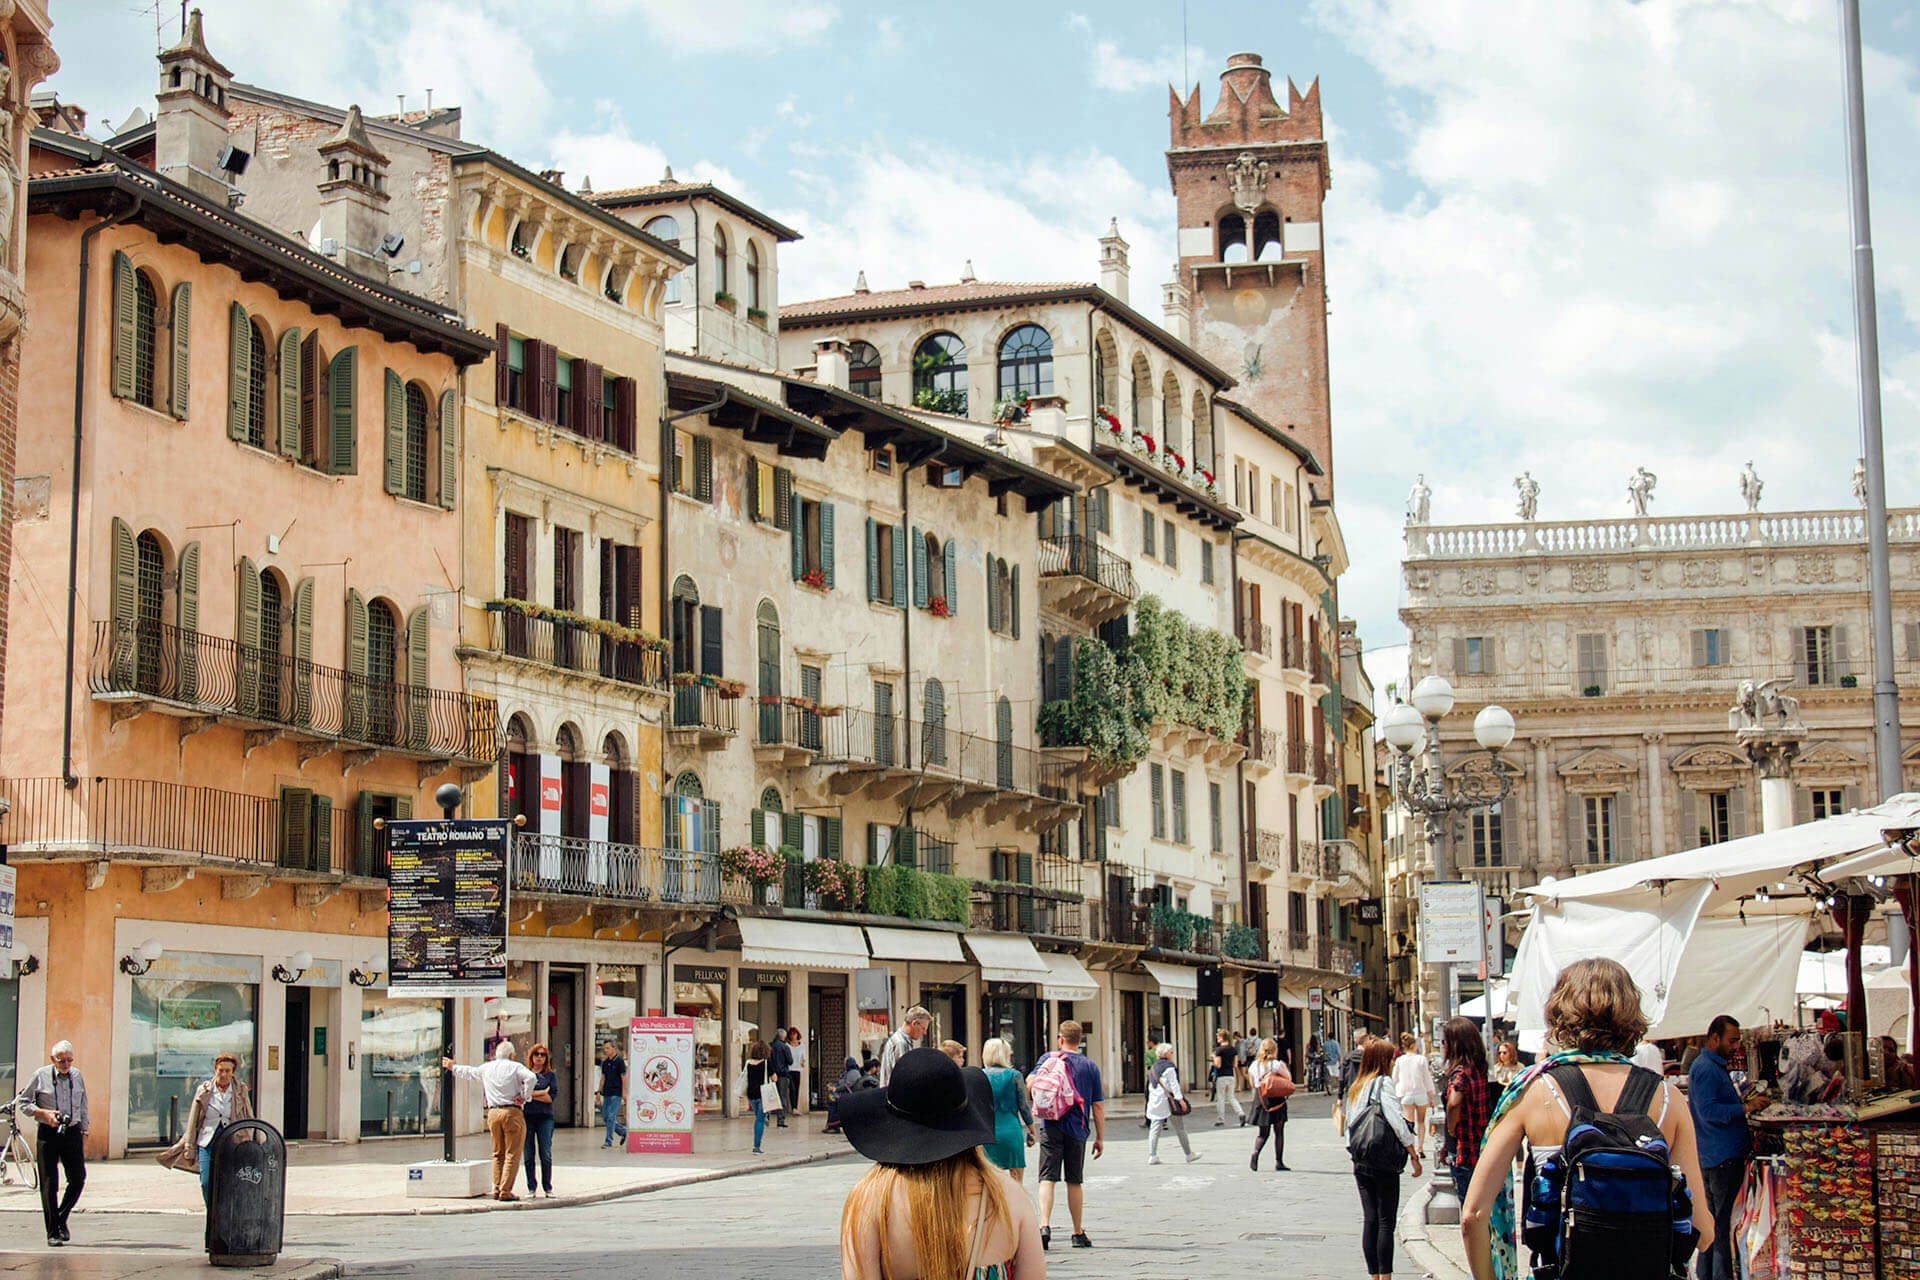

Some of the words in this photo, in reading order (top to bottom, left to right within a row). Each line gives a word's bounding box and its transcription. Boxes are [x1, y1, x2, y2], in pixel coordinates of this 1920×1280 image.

[416, 831, 447, 841] TEATRO
[449, 831, 484, 841] ROMANO
[694, 969, 727, 981] PELLICANO
[756, 973, 787, 984] PELLICANO
